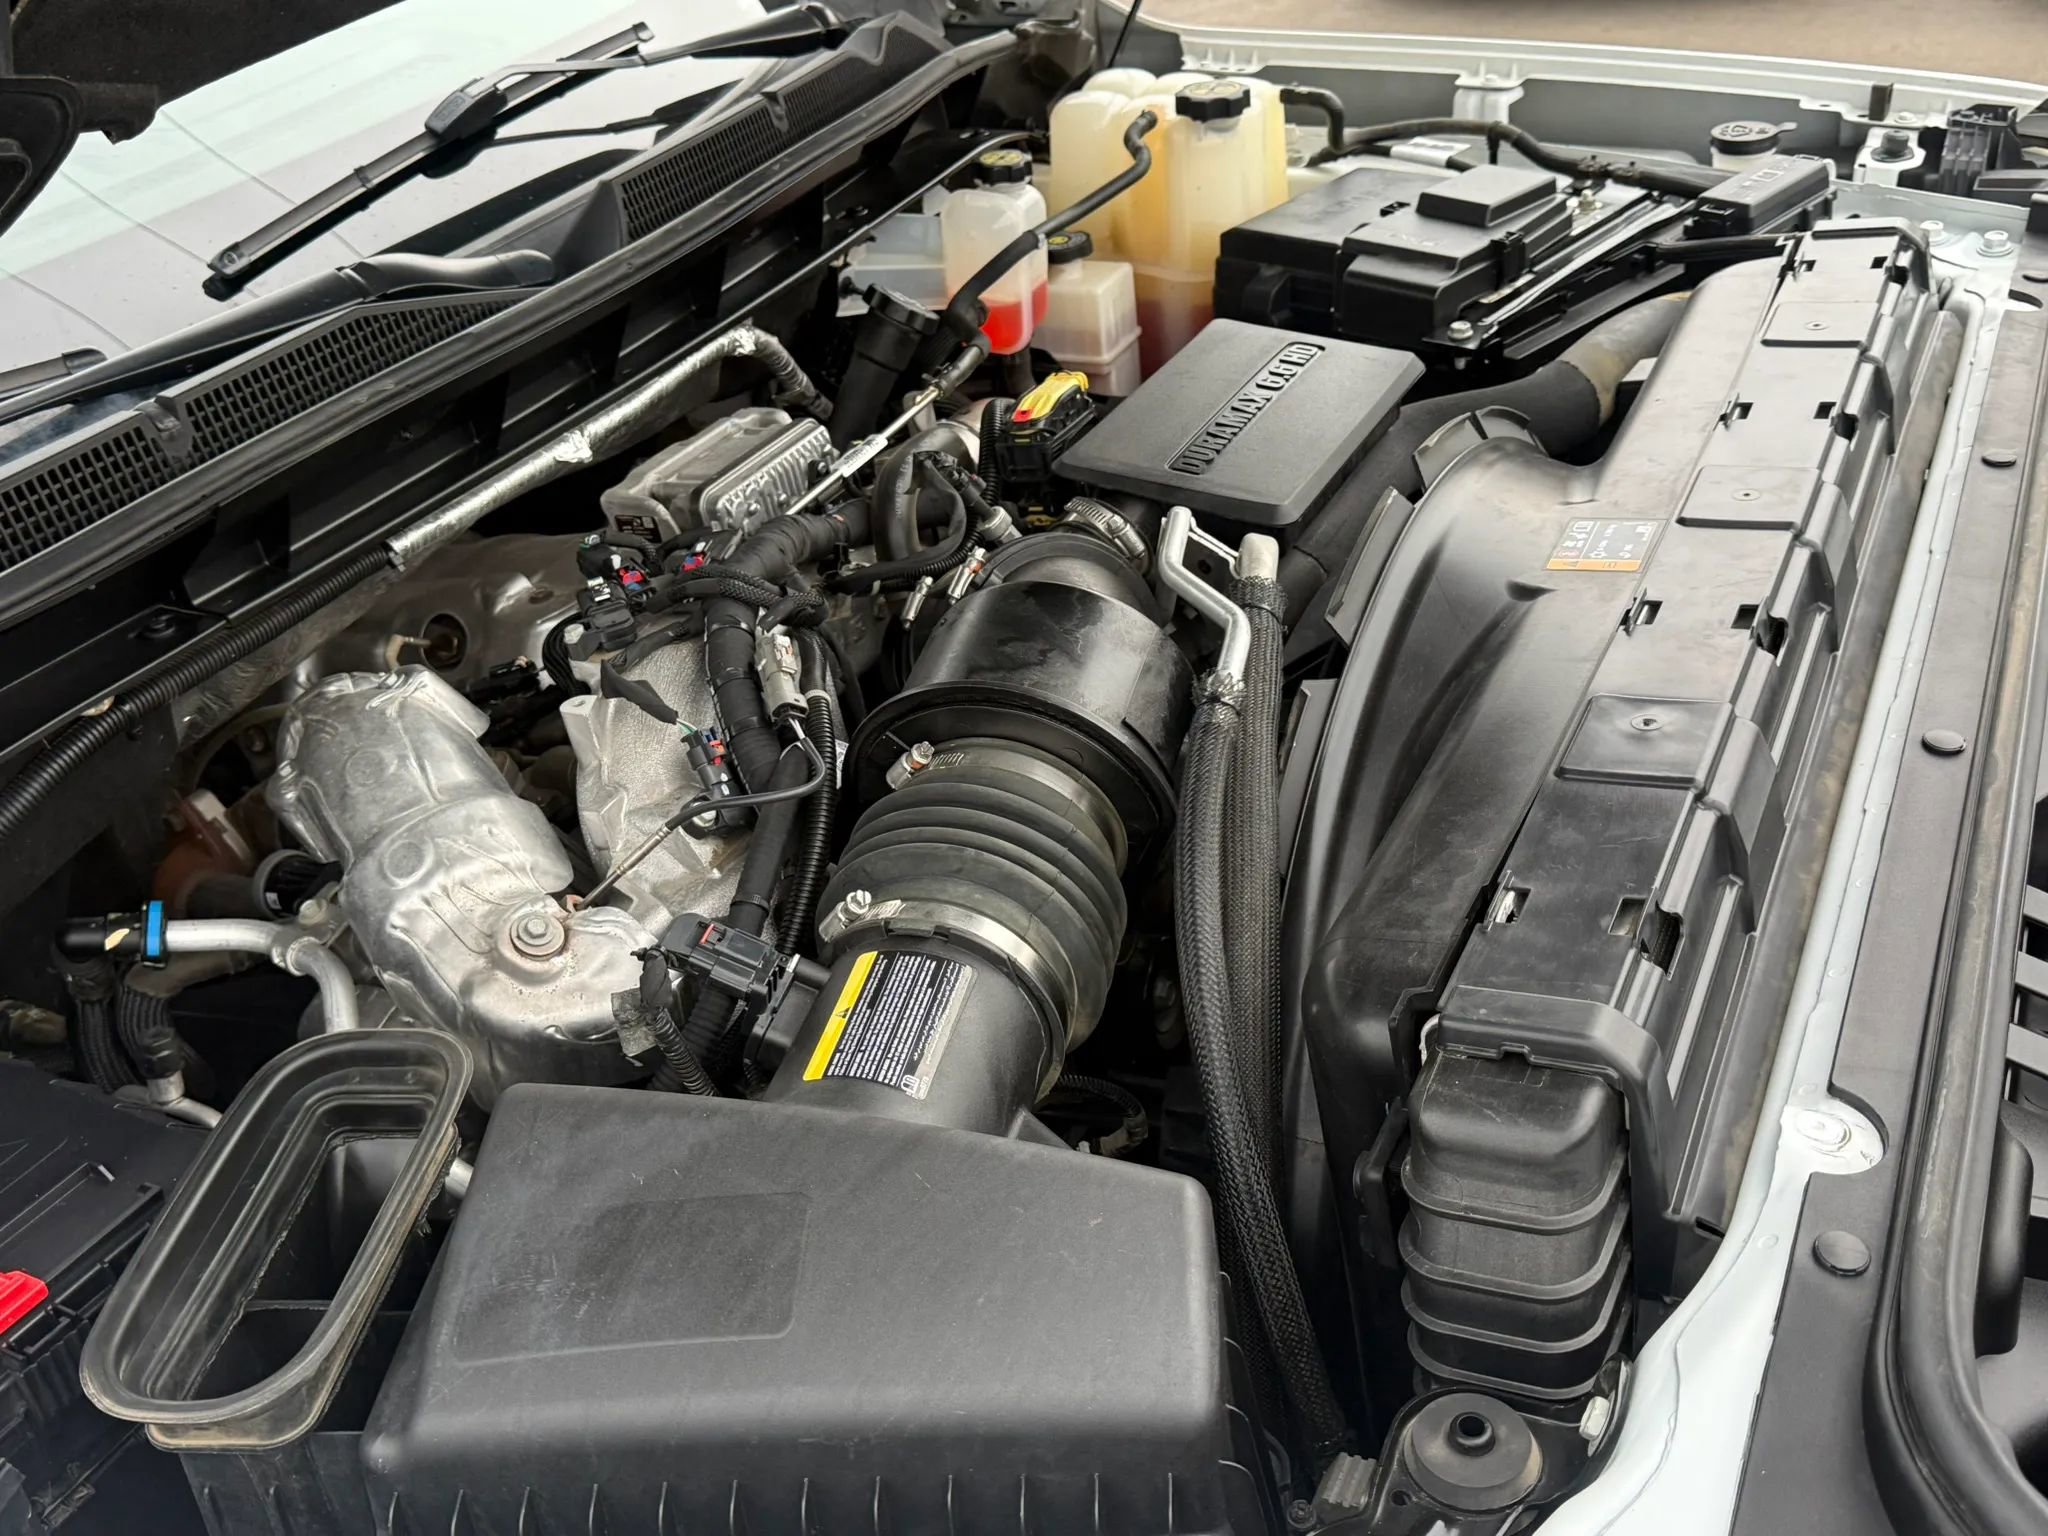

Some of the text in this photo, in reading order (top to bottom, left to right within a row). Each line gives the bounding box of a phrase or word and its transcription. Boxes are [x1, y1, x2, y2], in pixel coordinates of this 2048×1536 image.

[1171, 343, 1320, 476] DURAMAX 6.6 HD
